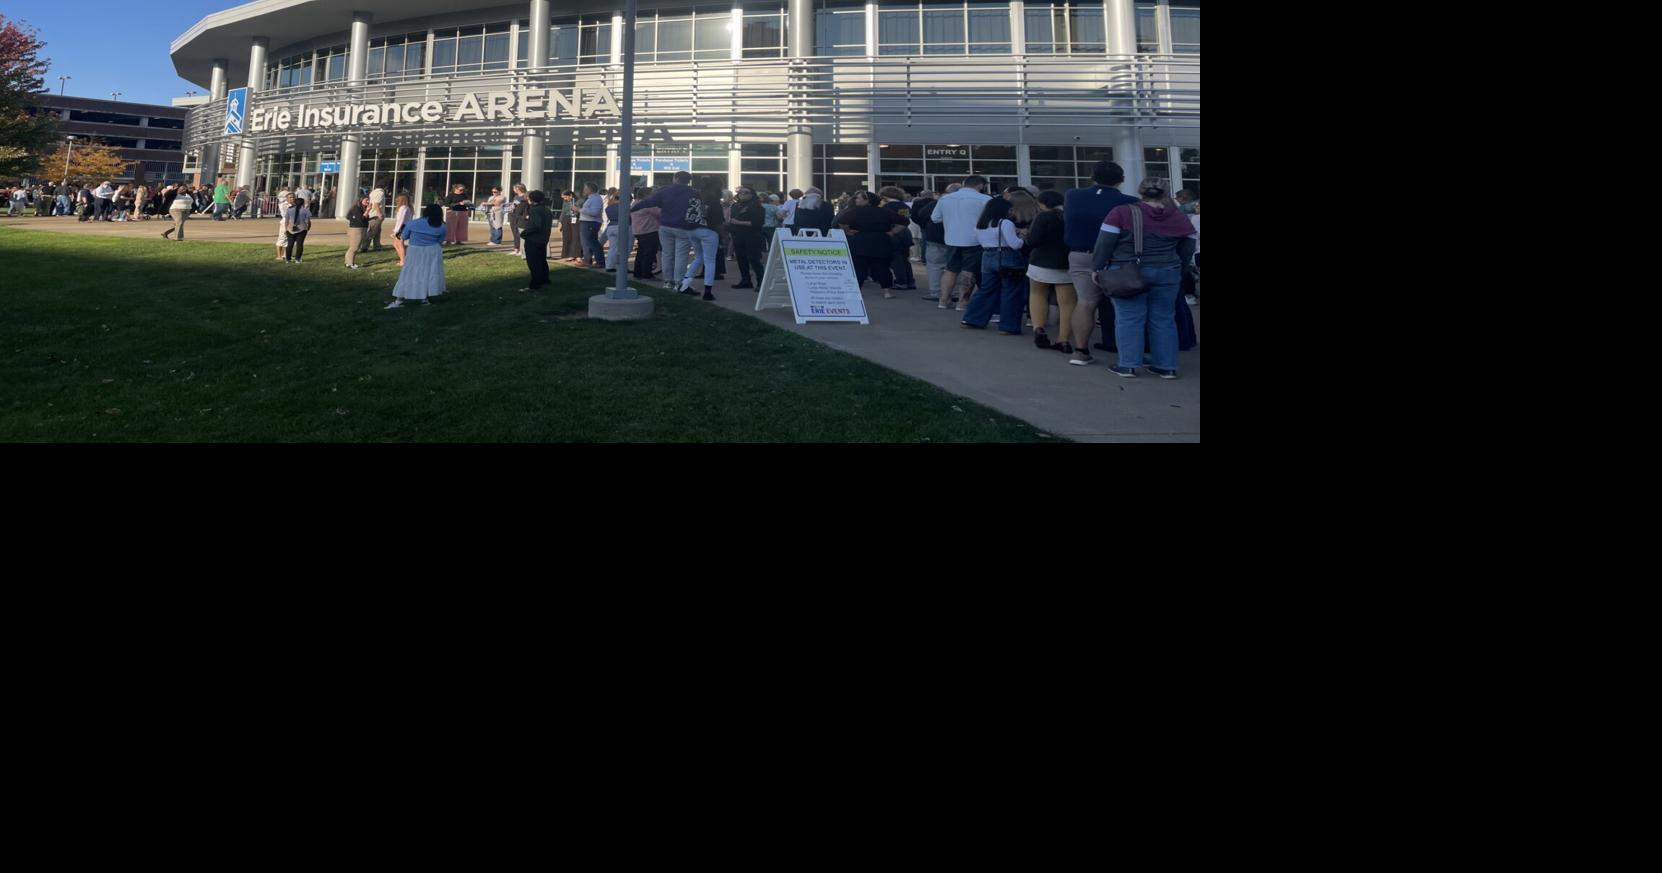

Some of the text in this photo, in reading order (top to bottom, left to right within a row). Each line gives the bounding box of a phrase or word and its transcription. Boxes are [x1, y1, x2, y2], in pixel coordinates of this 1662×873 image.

[251, 88, 622, 132] Erie Insurance ARENA
